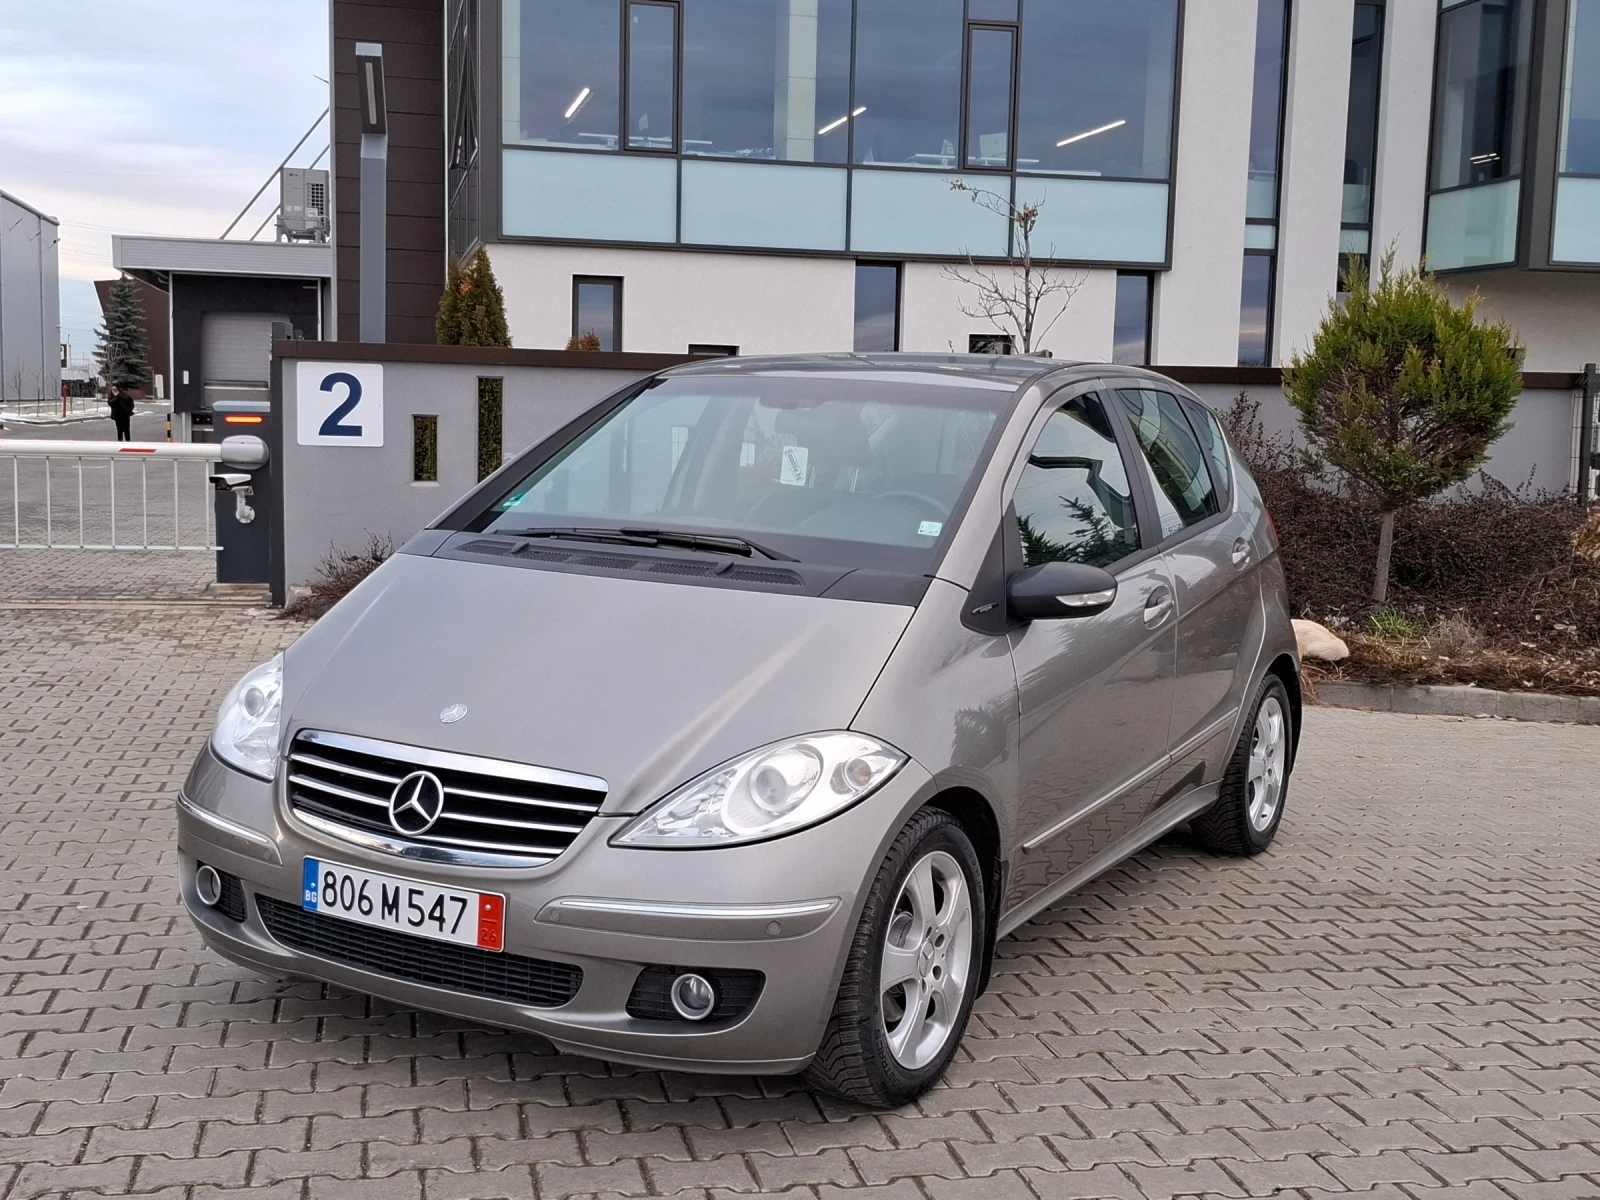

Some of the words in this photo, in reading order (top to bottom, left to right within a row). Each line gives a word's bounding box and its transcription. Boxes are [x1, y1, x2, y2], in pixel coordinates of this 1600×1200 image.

[319, 372, 362, 437] 2
[304, 889, 317, 903] BG
[322, 870, 373, 917] 806
[408, 888, 468, 934] 547
[481, 927, 497, 942] 26
